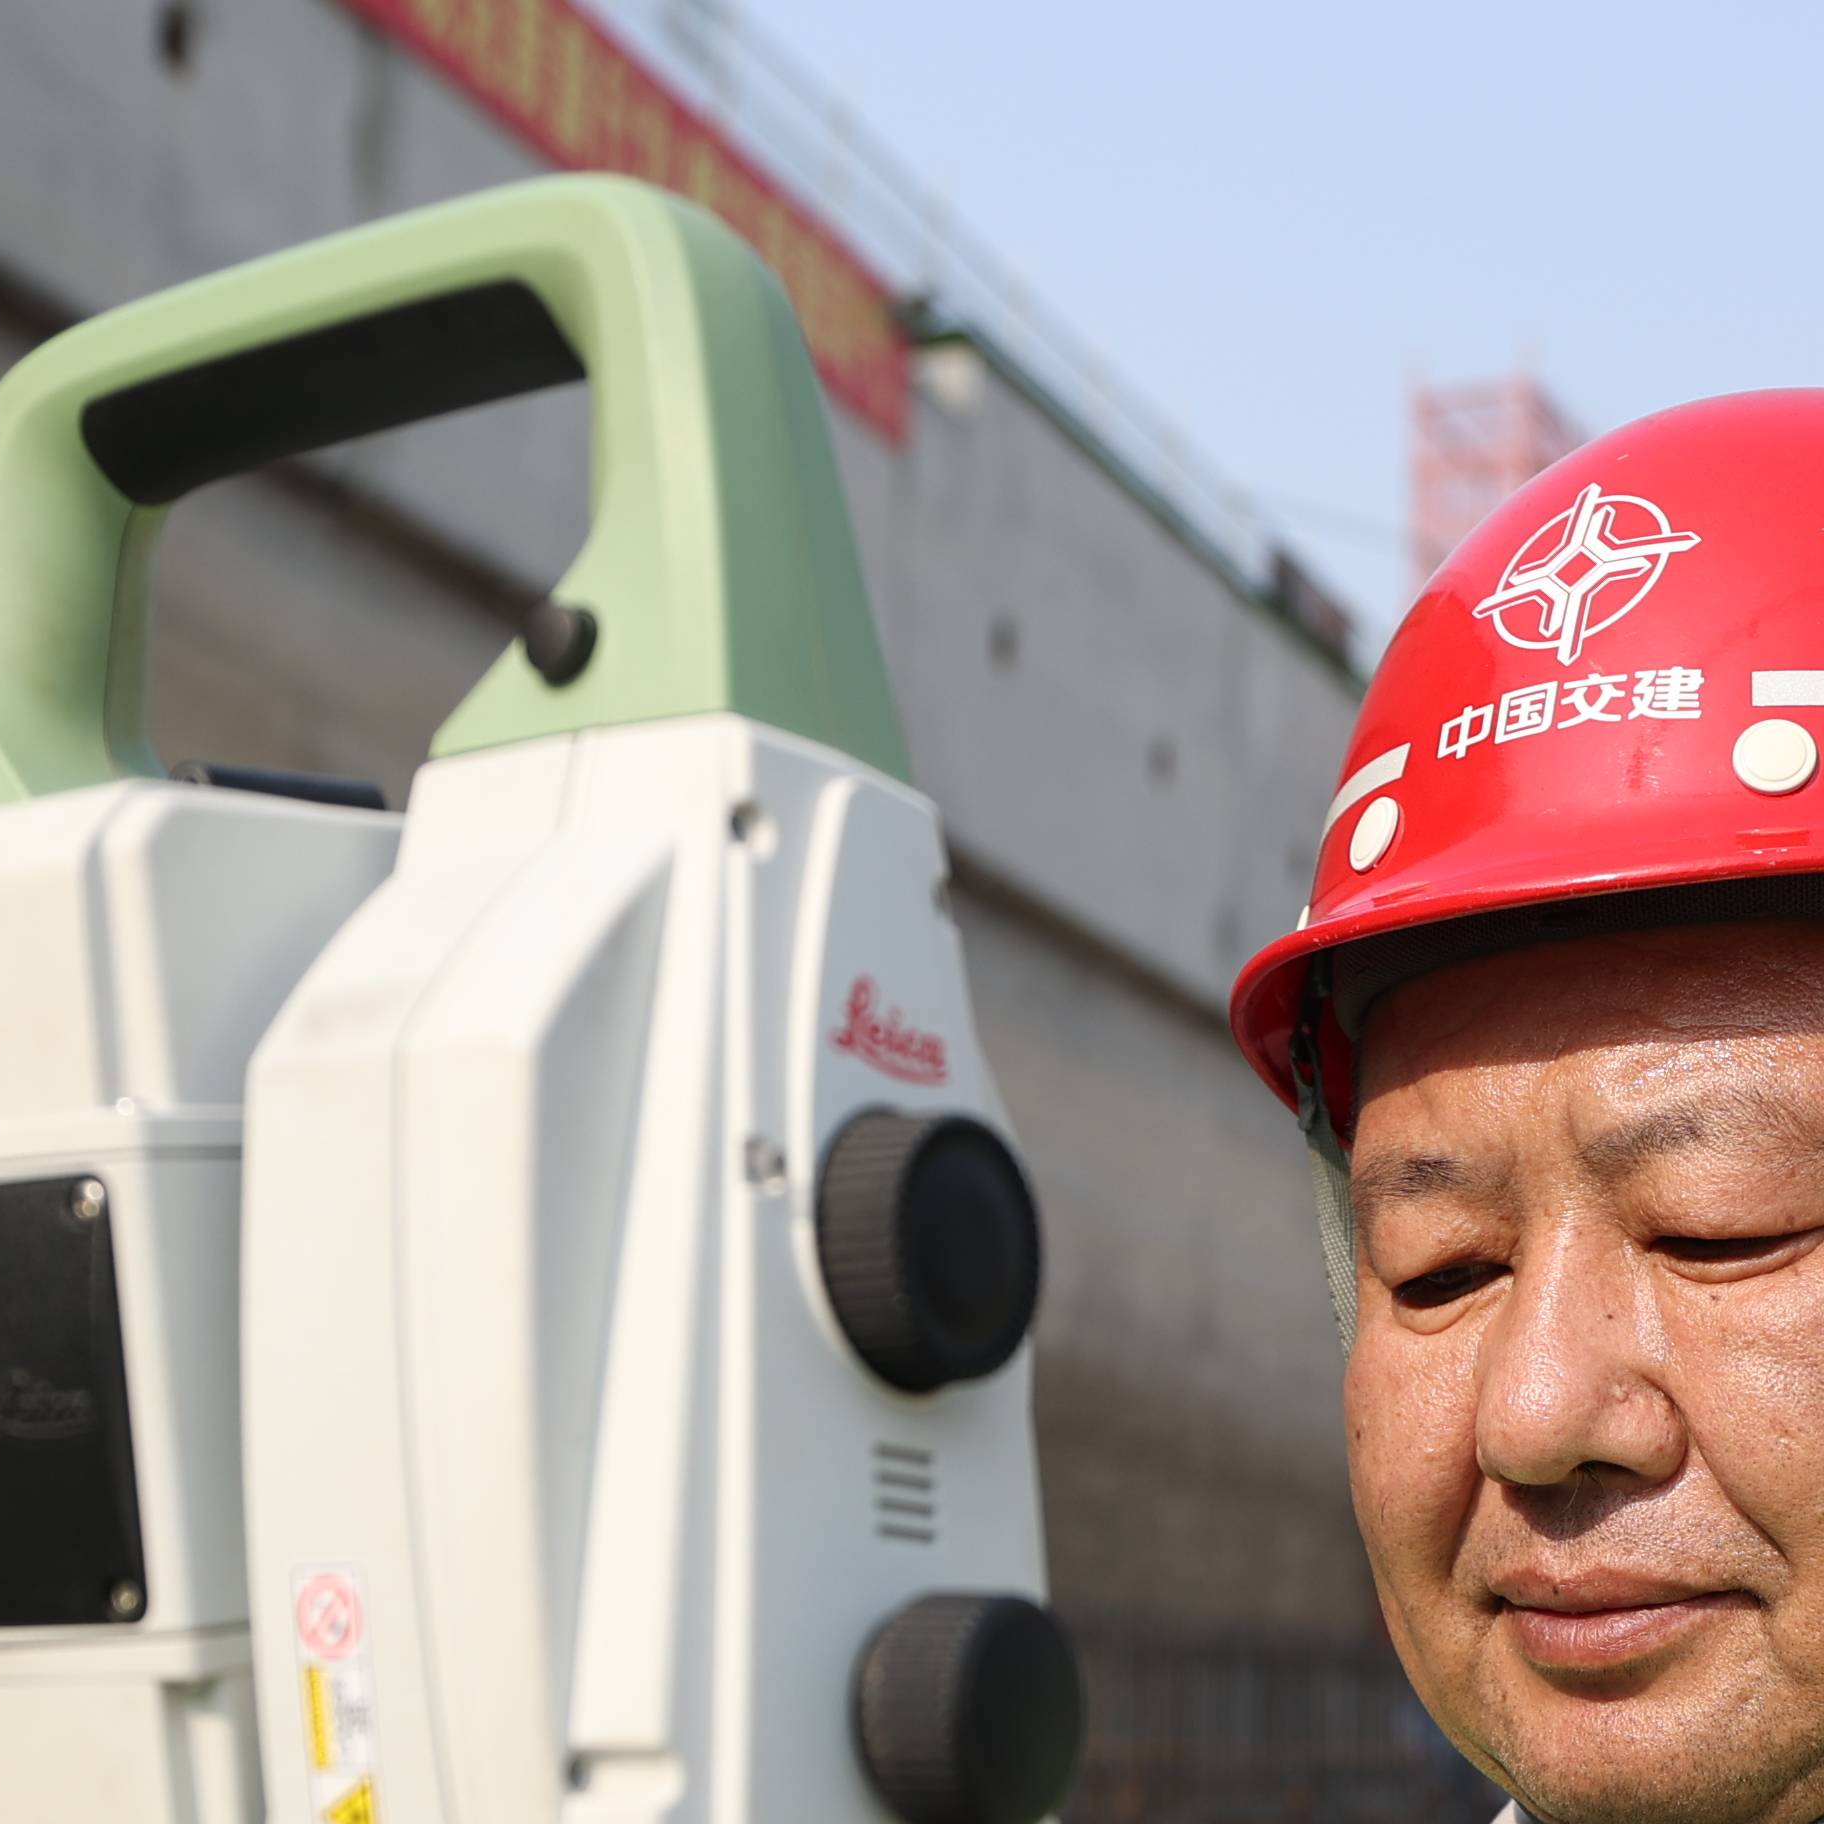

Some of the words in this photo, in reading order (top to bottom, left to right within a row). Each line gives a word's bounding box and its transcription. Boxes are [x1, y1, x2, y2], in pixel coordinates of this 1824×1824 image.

[1437, 665, 1705, 760] 中国交建
[830, 972, 949, 1085] Leica
